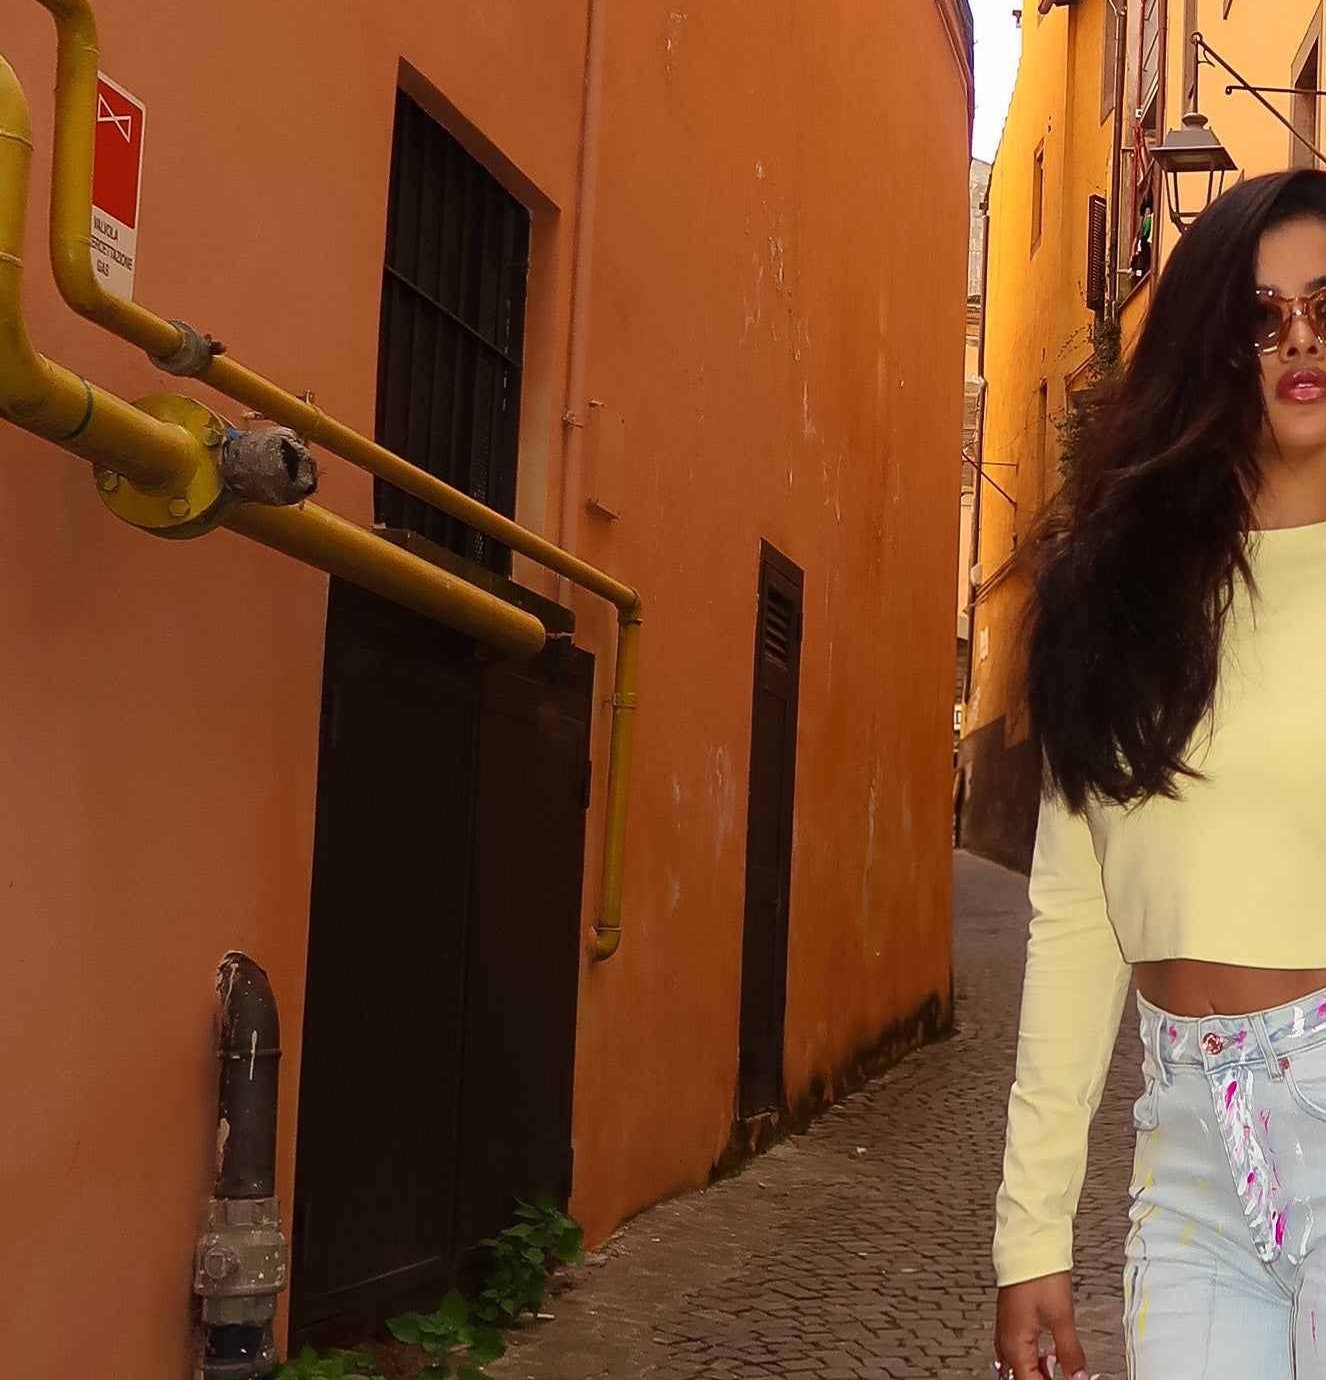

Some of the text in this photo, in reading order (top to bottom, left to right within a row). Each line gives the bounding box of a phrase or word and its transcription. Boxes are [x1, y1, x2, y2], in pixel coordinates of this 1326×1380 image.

[94, 216, 118, 240] VALVOLA
[90, 235, 133, 271] ERCETTAZIONE
[97, 259, 109, 277] GAS
